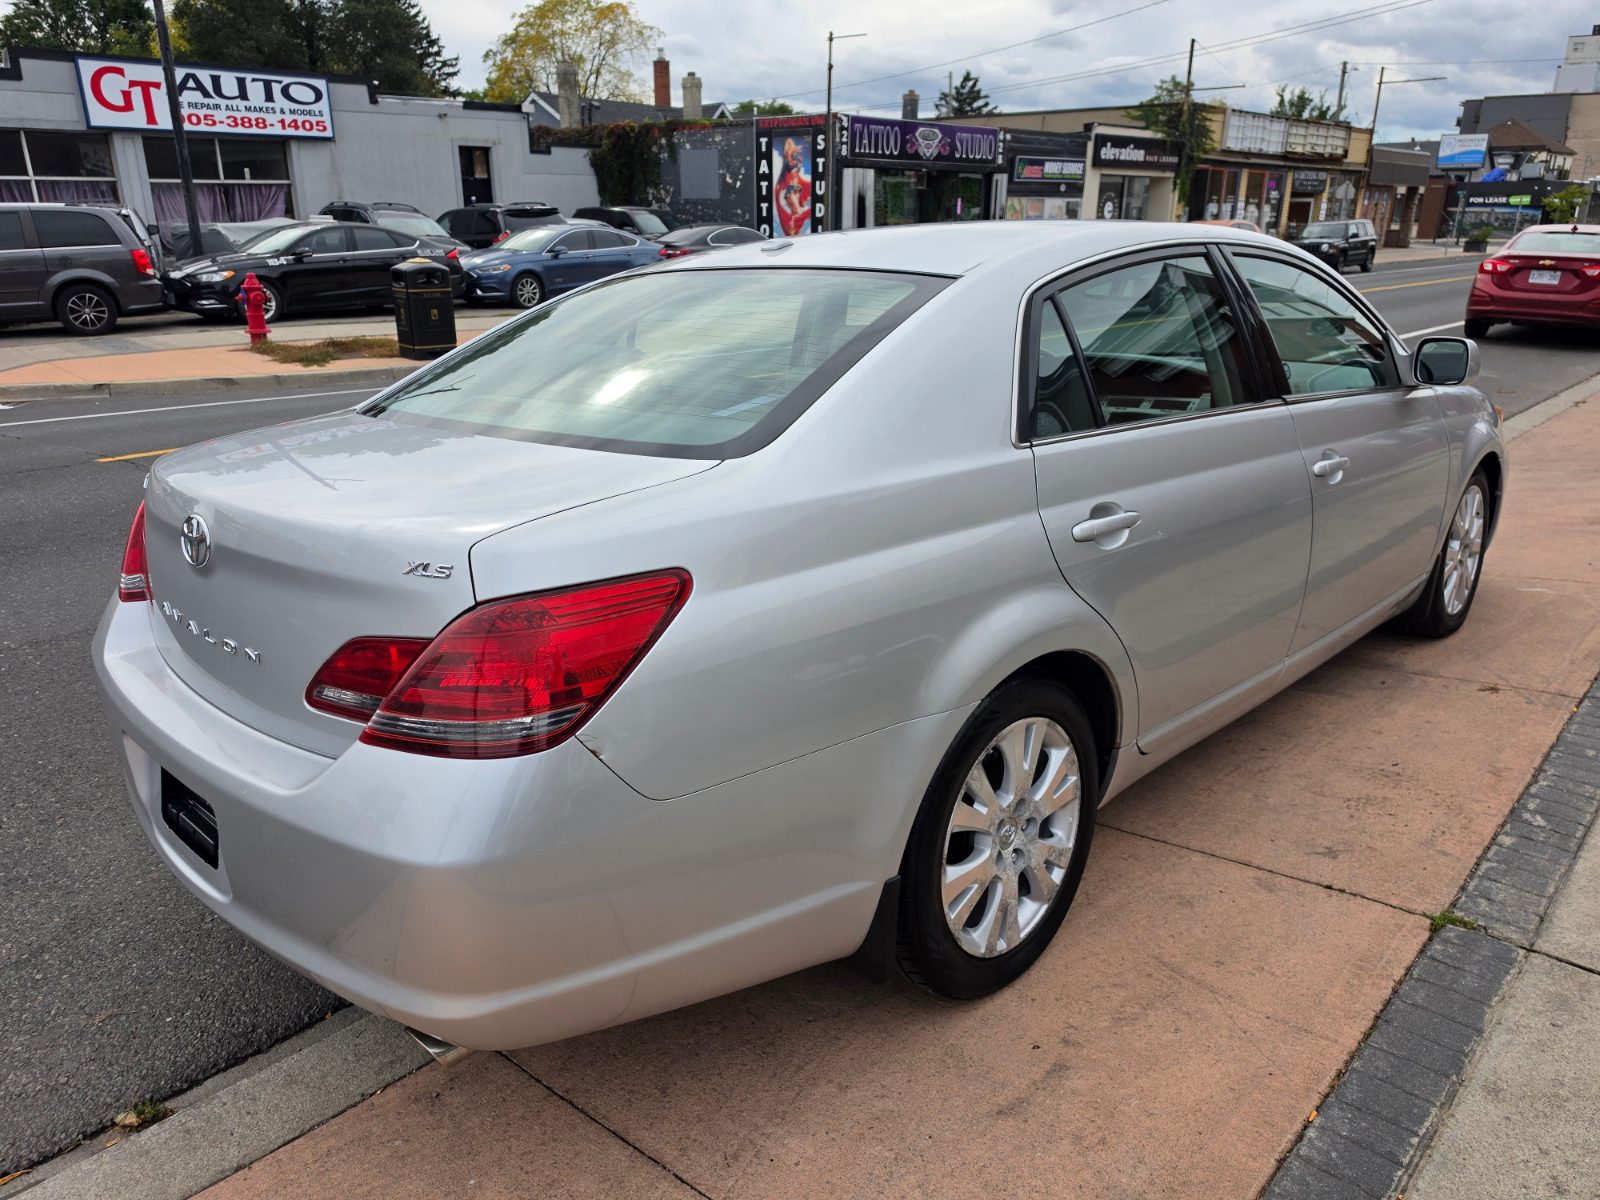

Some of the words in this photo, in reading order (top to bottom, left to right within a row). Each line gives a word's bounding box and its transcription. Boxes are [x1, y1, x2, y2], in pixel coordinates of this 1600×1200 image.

[90, 66, 162, 126] GT
[178, 72, 324, 106] AUTO
[187, 102, 222, 111] REPAIR
[225, 103, 242, 112] ALL
[244, 105, 277, 115] MAKES
[279, 107, 286, 115] &
[289, 108, 324, 117] MODELS
[853, 123, 901, 156] TATTOO
[954, 132, 995, 160] STUDIO
[1100, 141, 1146, 162] elevation
[1469, 196, 1484, 204] FOR
[1485, 196, 1508, 204] LEASE
[401, 560, 454, 579] XLS
[162, 602, 261, 665] AVALON
